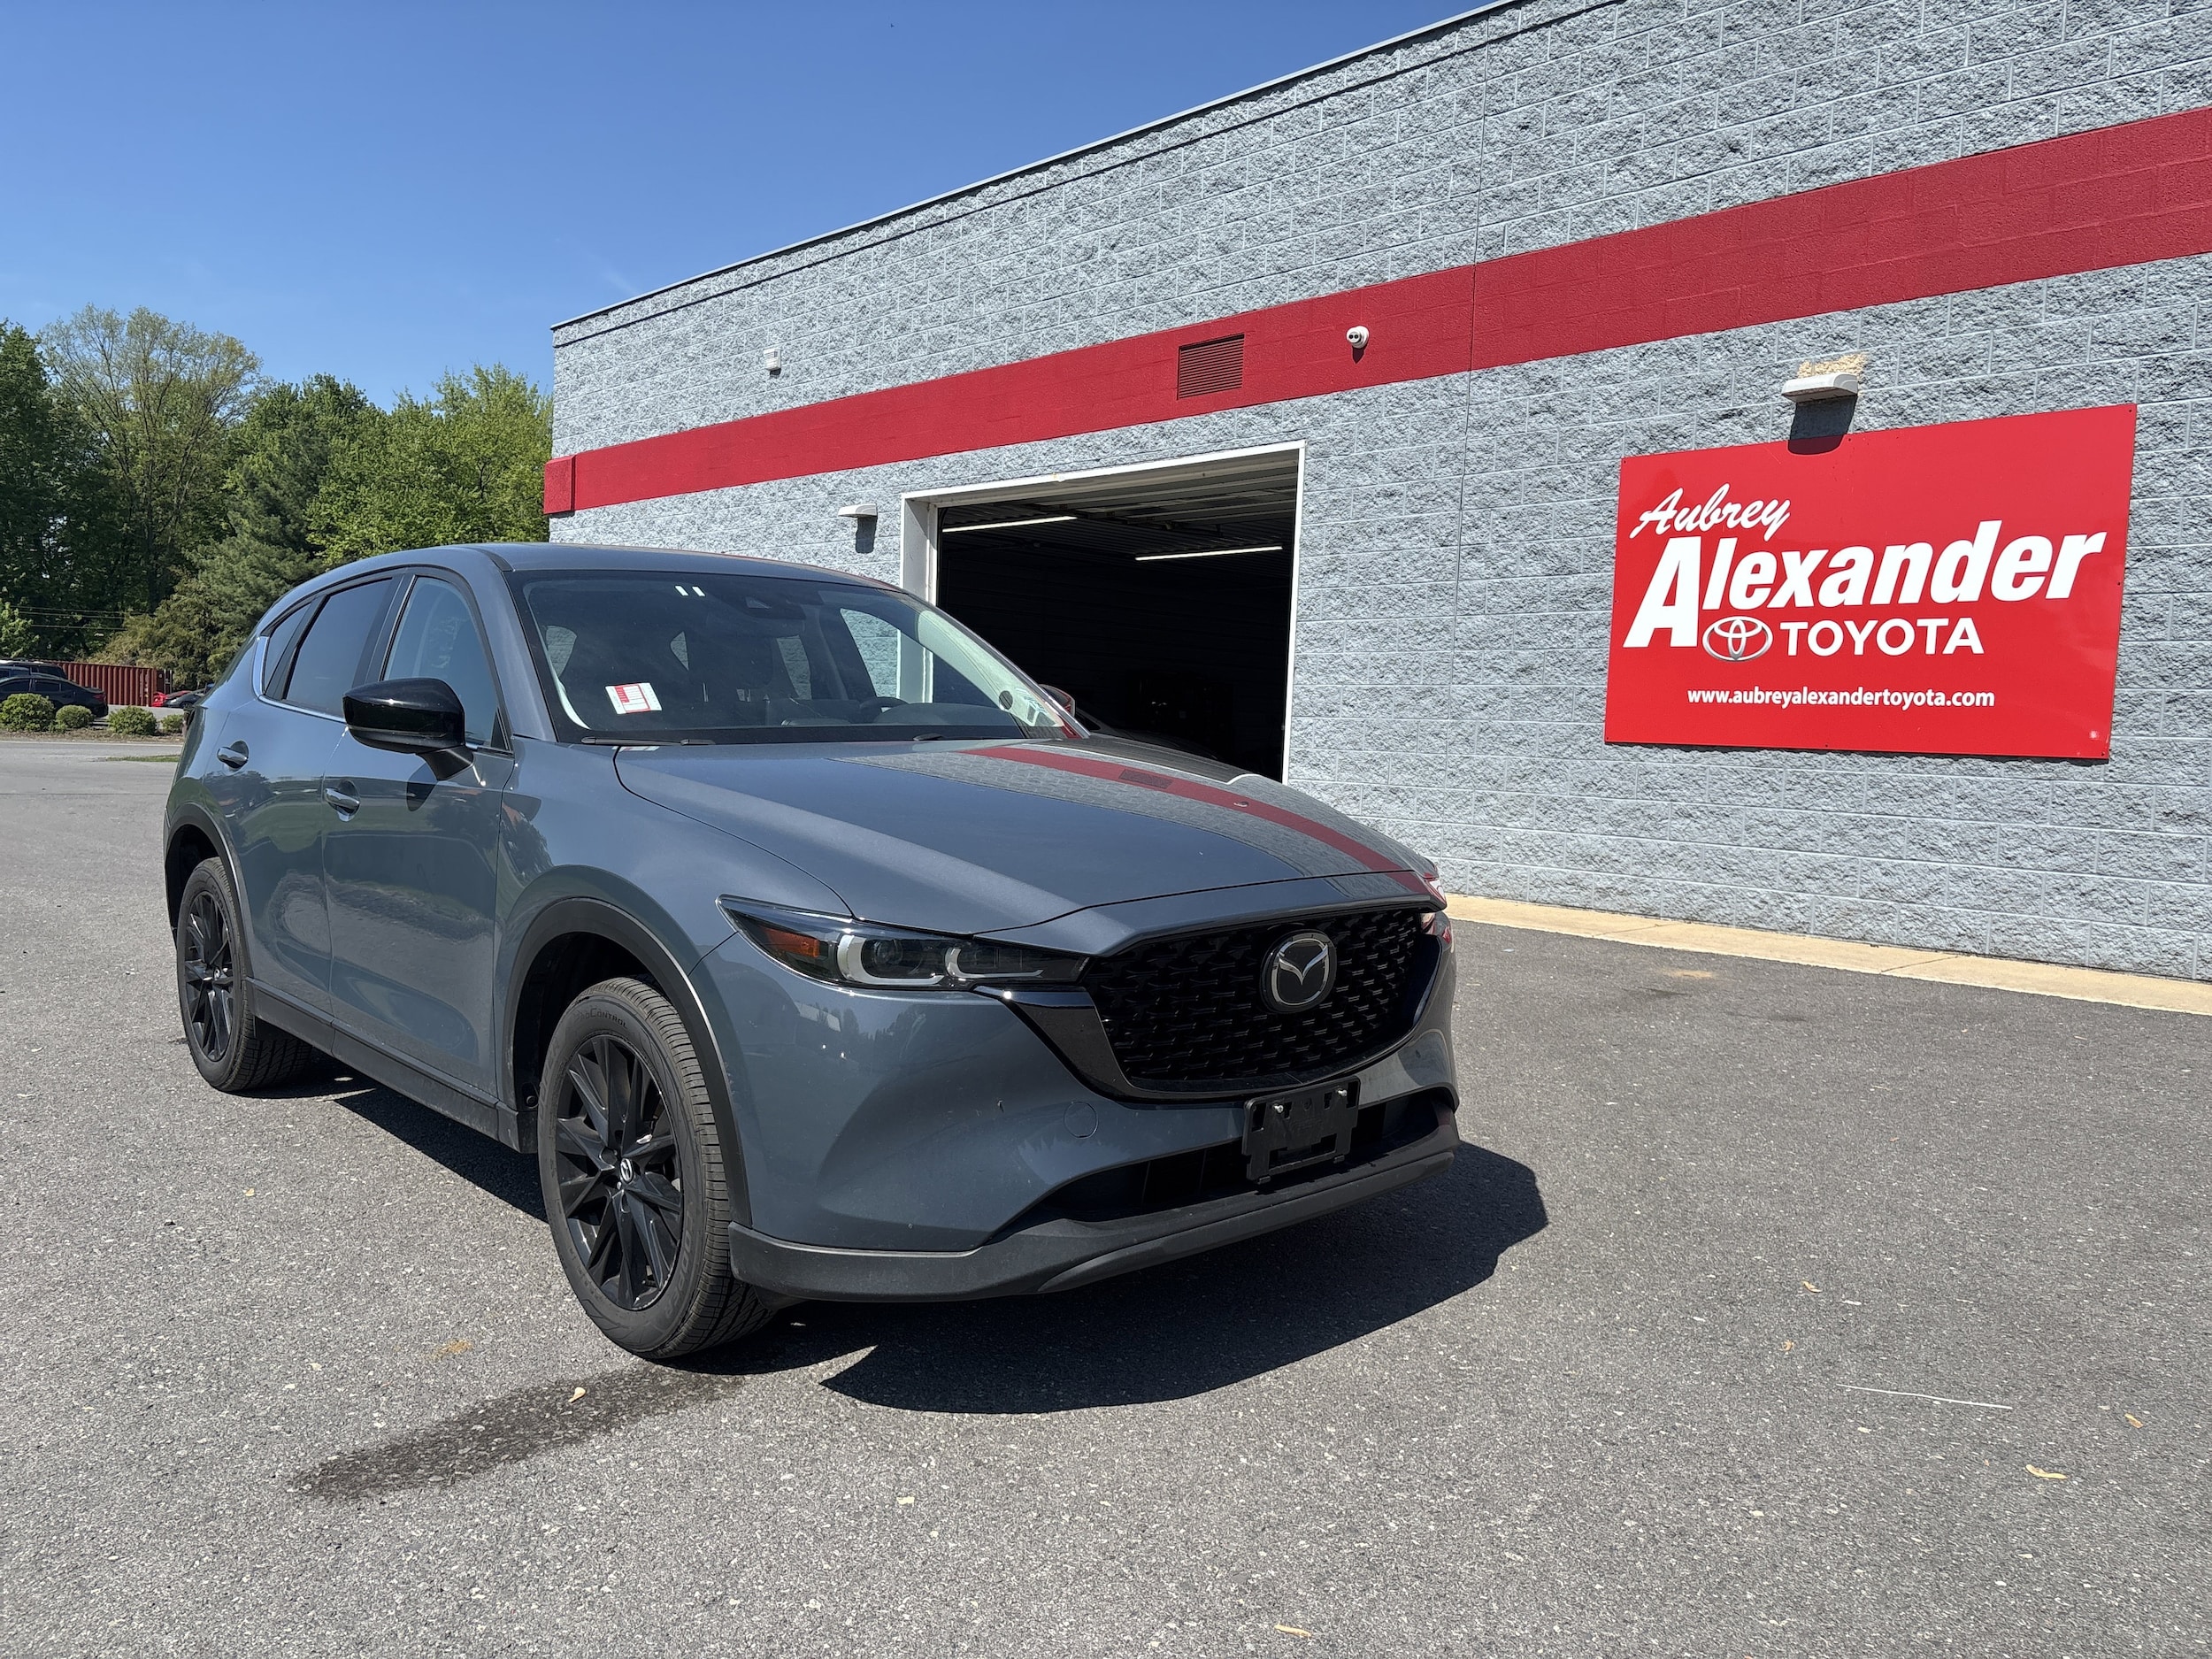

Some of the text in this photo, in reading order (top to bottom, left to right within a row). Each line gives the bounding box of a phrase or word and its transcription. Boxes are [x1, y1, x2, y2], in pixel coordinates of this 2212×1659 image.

[1630, 483, 1791, 541] Aubrey
[1624, 520, 2108, 649] Alexander
[1779, 618, 1985, 657] TOYOTA
[1687, 686, 1995, 711] www.aubreyalexandertoyota.com
